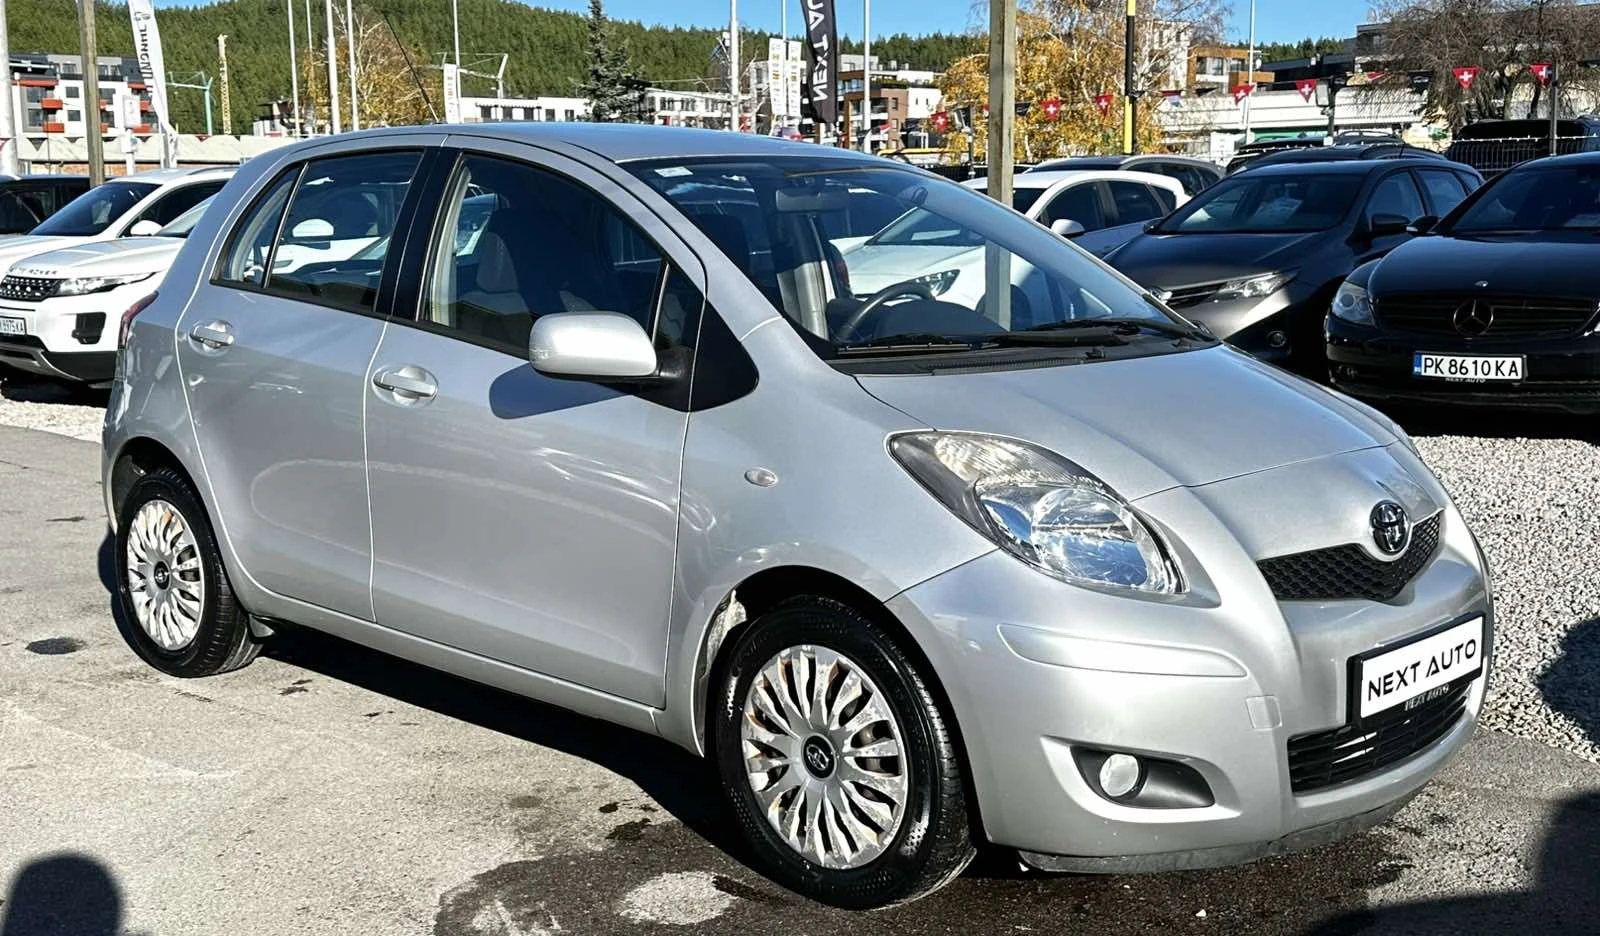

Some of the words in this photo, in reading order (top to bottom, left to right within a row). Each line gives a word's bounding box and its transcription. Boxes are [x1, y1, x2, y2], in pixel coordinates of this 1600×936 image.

[1448, 359, 1491, 376] 8610
[1367, 660, 1421, 702] NEXT
[1425, 638, 1476, 678] AUTO
